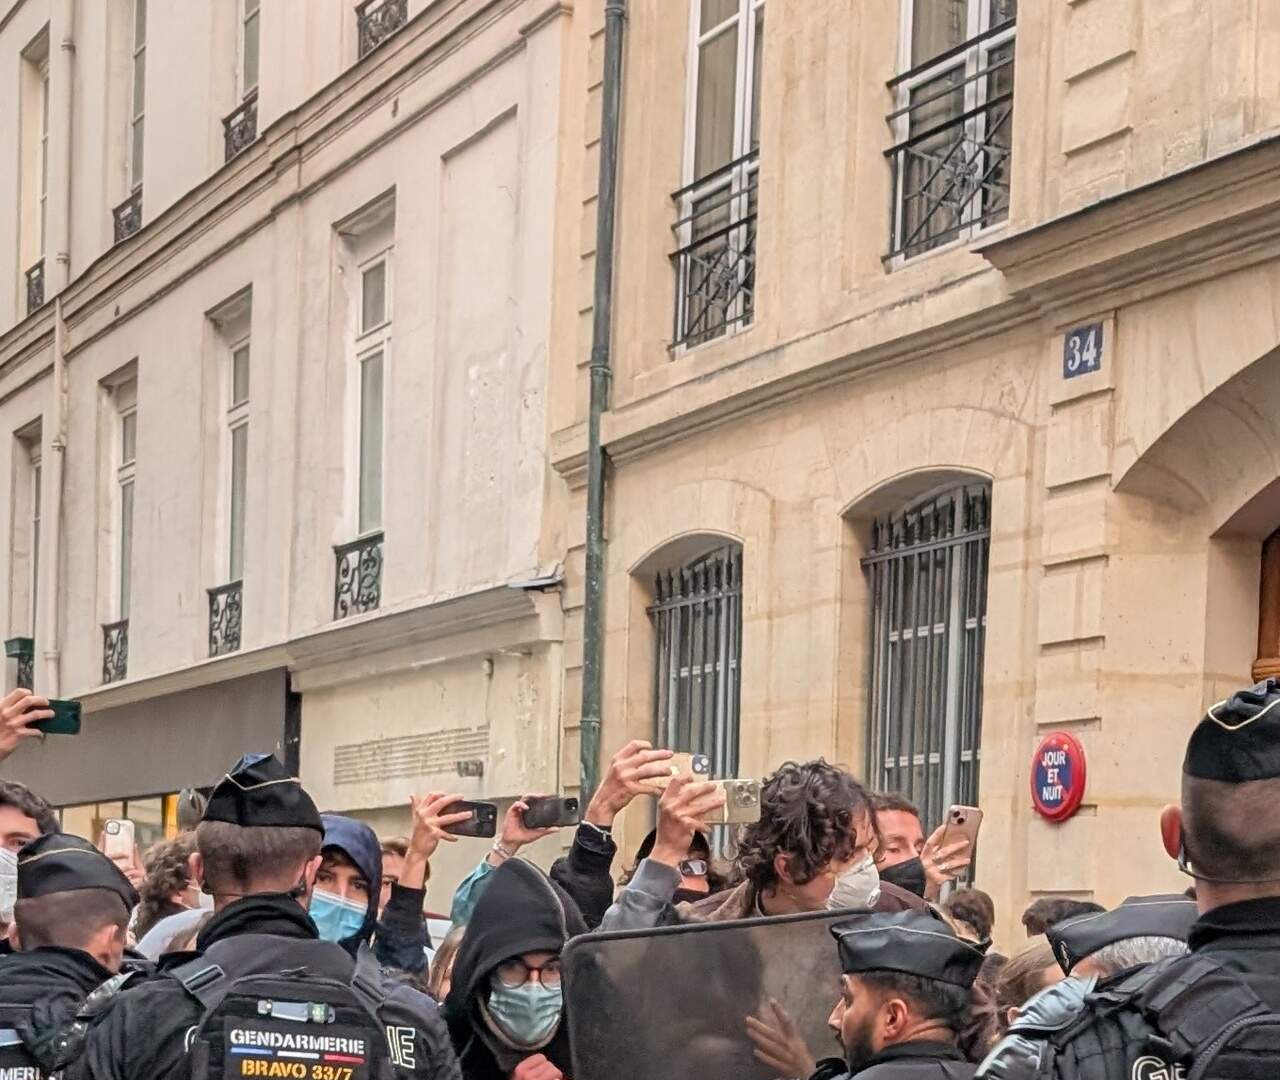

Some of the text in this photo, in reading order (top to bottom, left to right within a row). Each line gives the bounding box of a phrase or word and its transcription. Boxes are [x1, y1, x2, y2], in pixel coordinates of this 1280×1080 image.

[1068, 330, 1097, 370] 34
[1042, 751, 1066, 767] JOUR
[1047, 768, 1059, 784] ET
[1042, 785, 1063, 801] NUIT
[230, 1029, 365, 1055] GENDARMERIE
[241, 1059, 308, 1079] BRAVO
